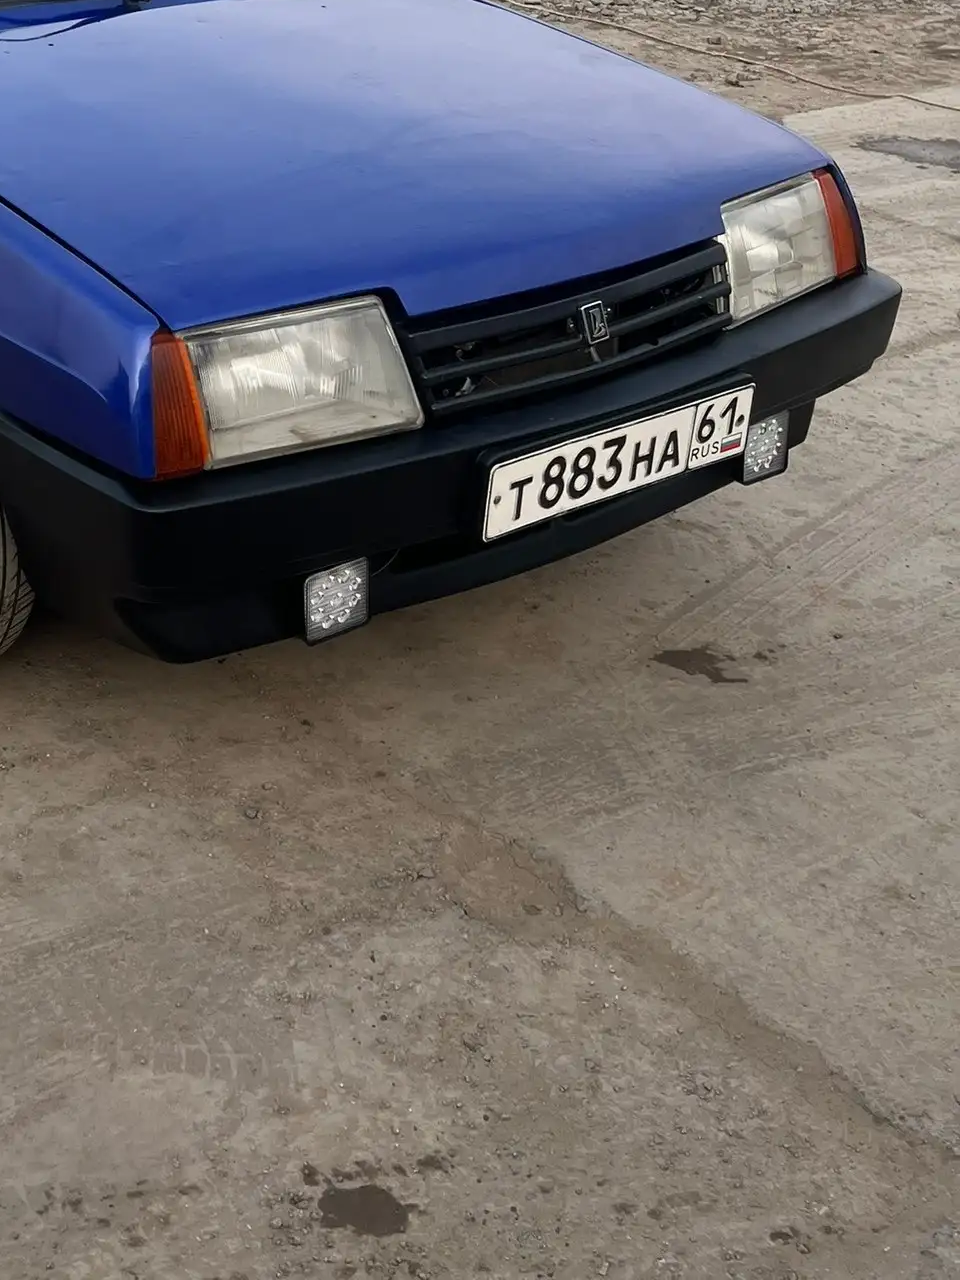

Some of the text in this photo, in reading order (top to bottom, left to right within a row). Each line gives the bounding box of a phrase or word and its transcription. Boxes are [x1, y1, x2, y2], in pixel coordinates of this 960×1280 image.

[509, 396, 739, 521] Т883НА 61
[690, 441, 720, 461] RUS
